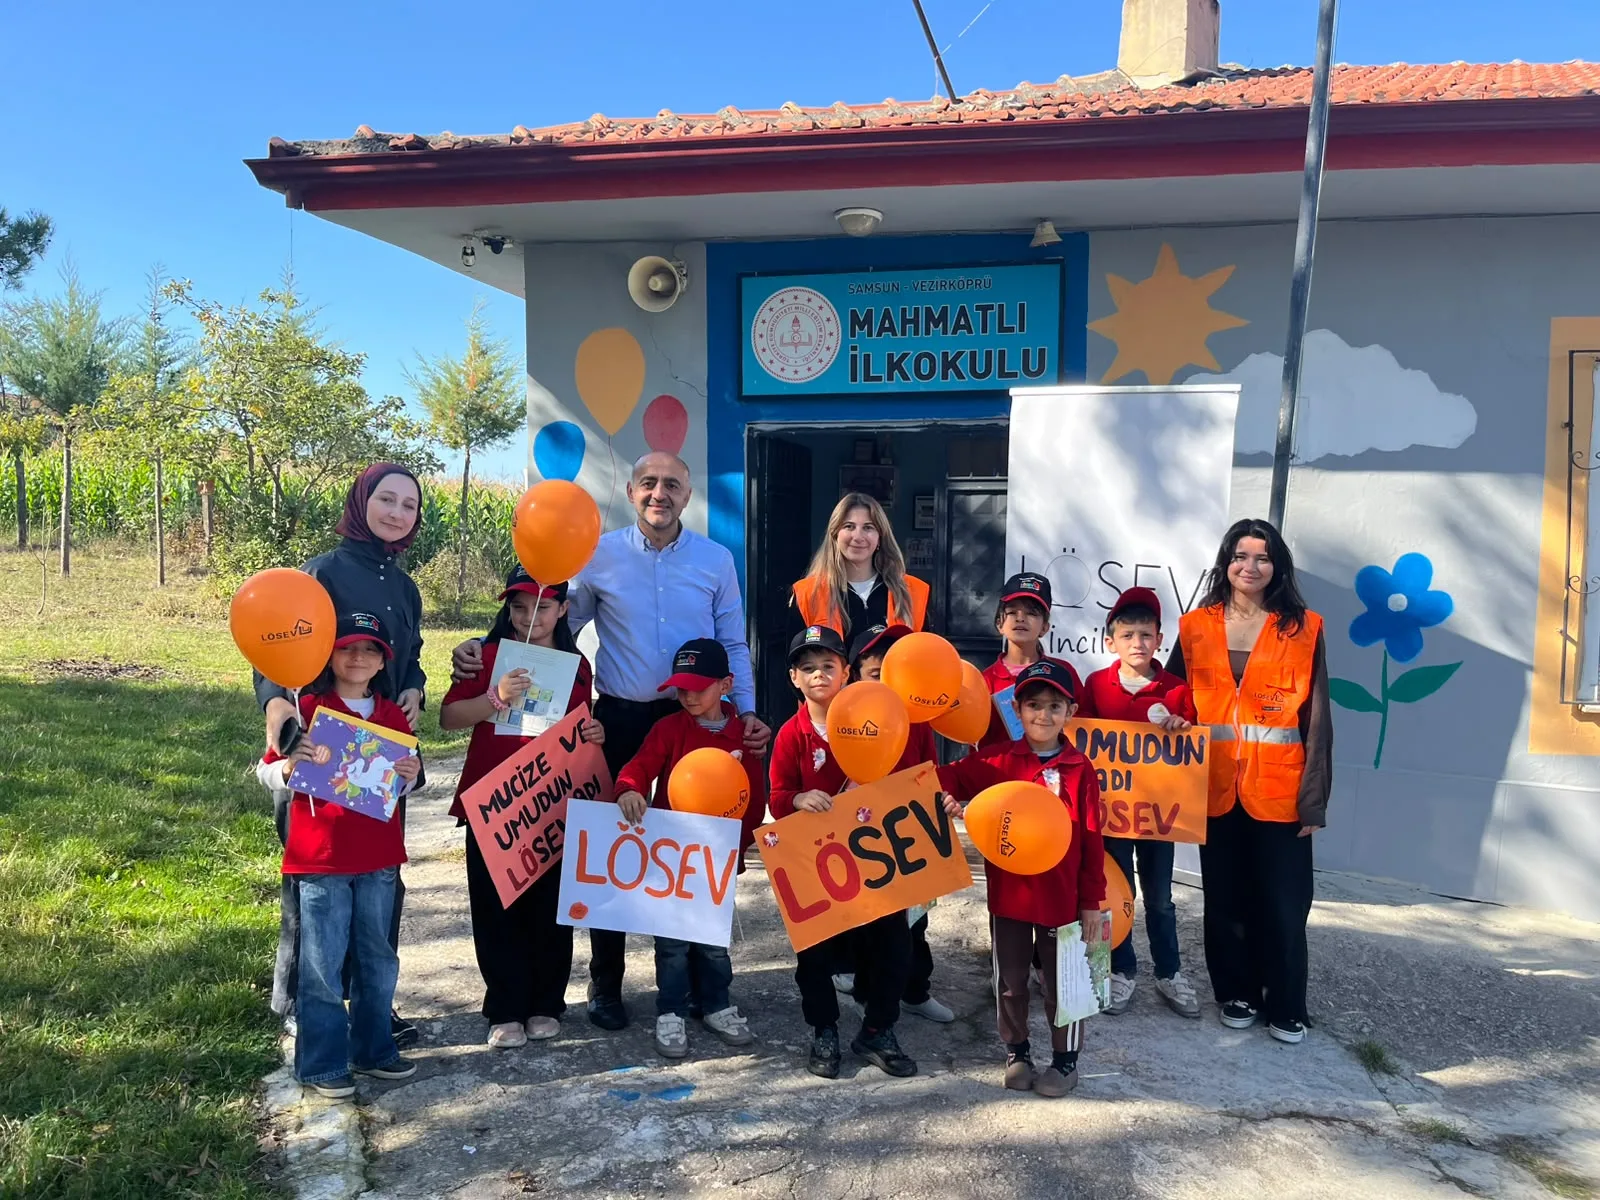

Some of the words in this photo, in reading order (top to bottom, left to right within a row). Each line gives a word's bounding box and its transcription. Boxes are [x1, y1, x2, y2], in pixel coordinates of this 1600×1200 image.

[848, 282, 900, 295] SAMSUN
[912, 276, 992, 292] VEZİRKÖPRÜ
[849, 301, 1027, 339] MAHMATLI
[849, 345, 1047, 384] İLKOKULU
[479, 752, 552, 824] MUCİZE
[494, 769, 573, 850] UMUDUN
[1099, 798, 1180, 835] SEV
[576, 820, 738, 906] LÖSEV
[773, 792, 952, 923] LÖSEV
